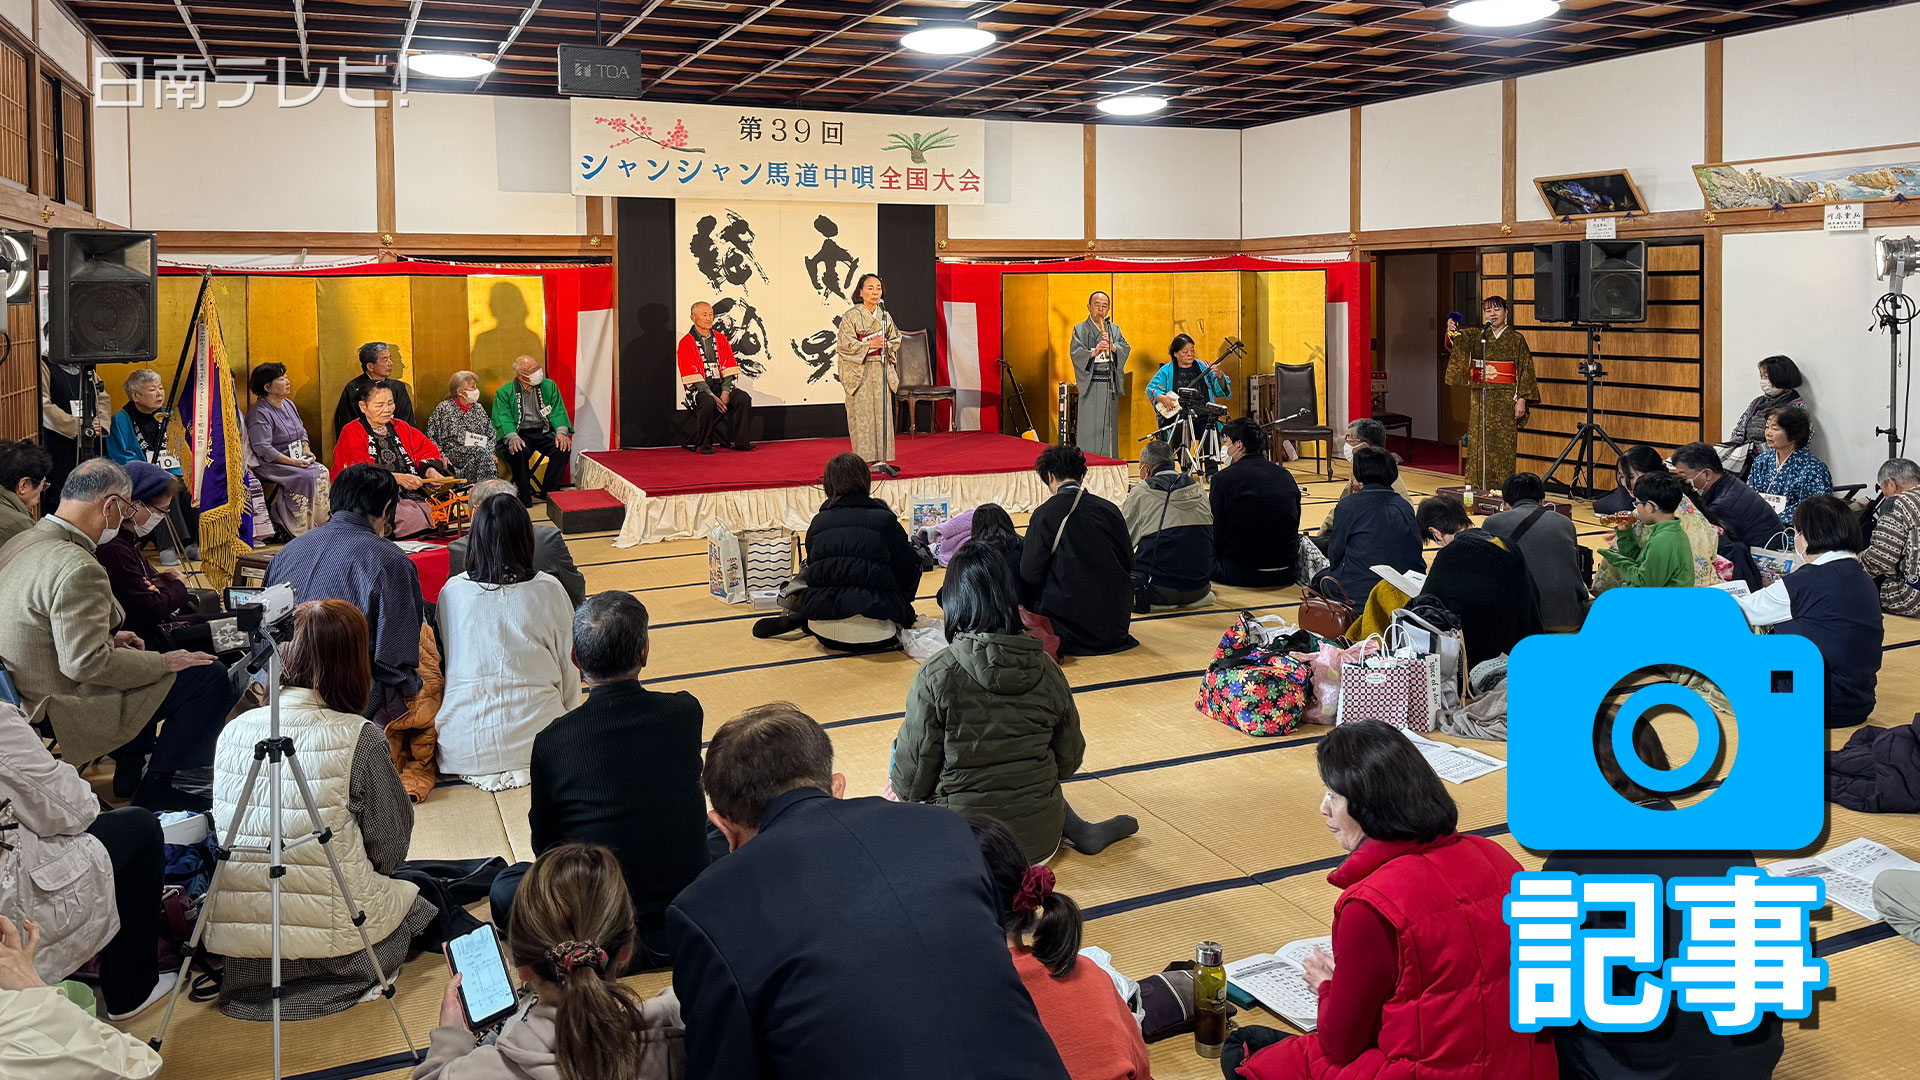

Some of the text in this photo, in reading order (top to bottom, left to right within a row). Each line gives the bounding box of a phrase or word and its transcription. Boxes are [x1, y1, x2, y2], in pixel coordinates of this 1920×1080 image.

[596, 64, 630, 79] TOA
[738, 115, 845, 146] 第39回
[581, 154, 981, 193] シャンシャン馬道中唄全国大会
[294, 450, 300, 459] 8
